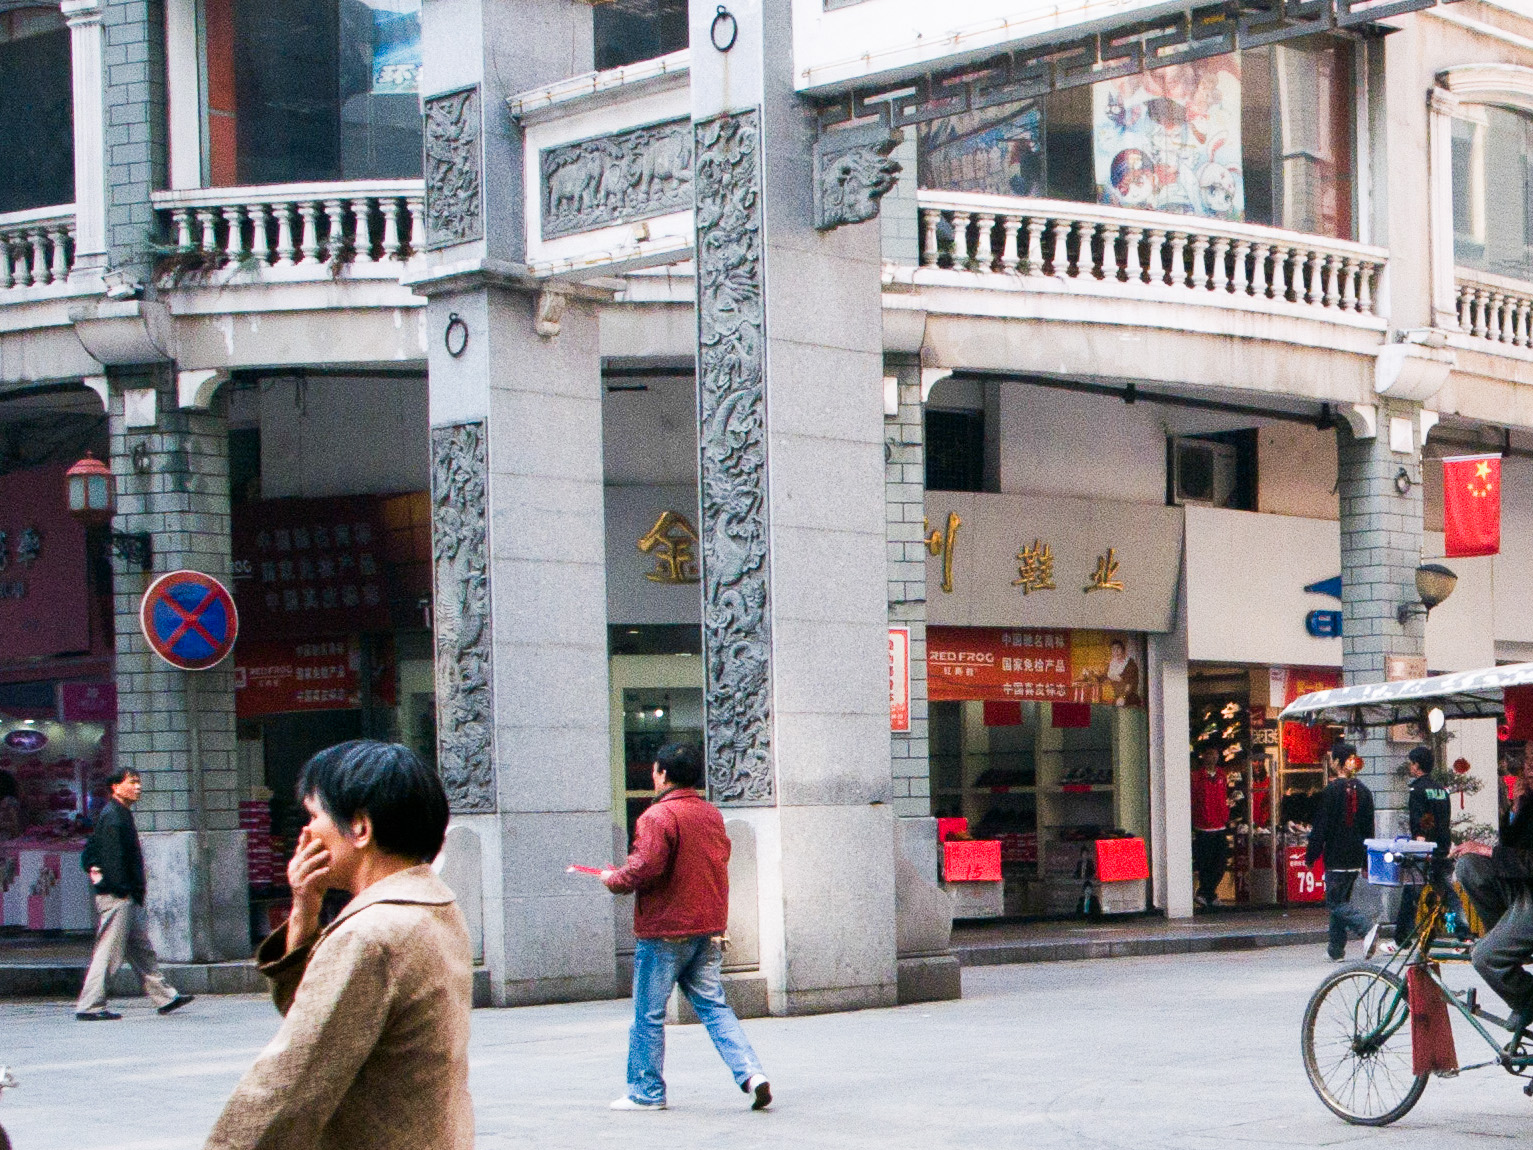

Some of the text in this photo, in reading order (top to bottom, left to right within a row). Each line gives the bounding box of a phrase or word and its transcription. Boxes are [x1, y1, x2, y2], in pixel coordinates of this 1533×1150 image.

[929, 651, 995, 664] RED FROG
[1297, 871, 1326, 893] 79-
